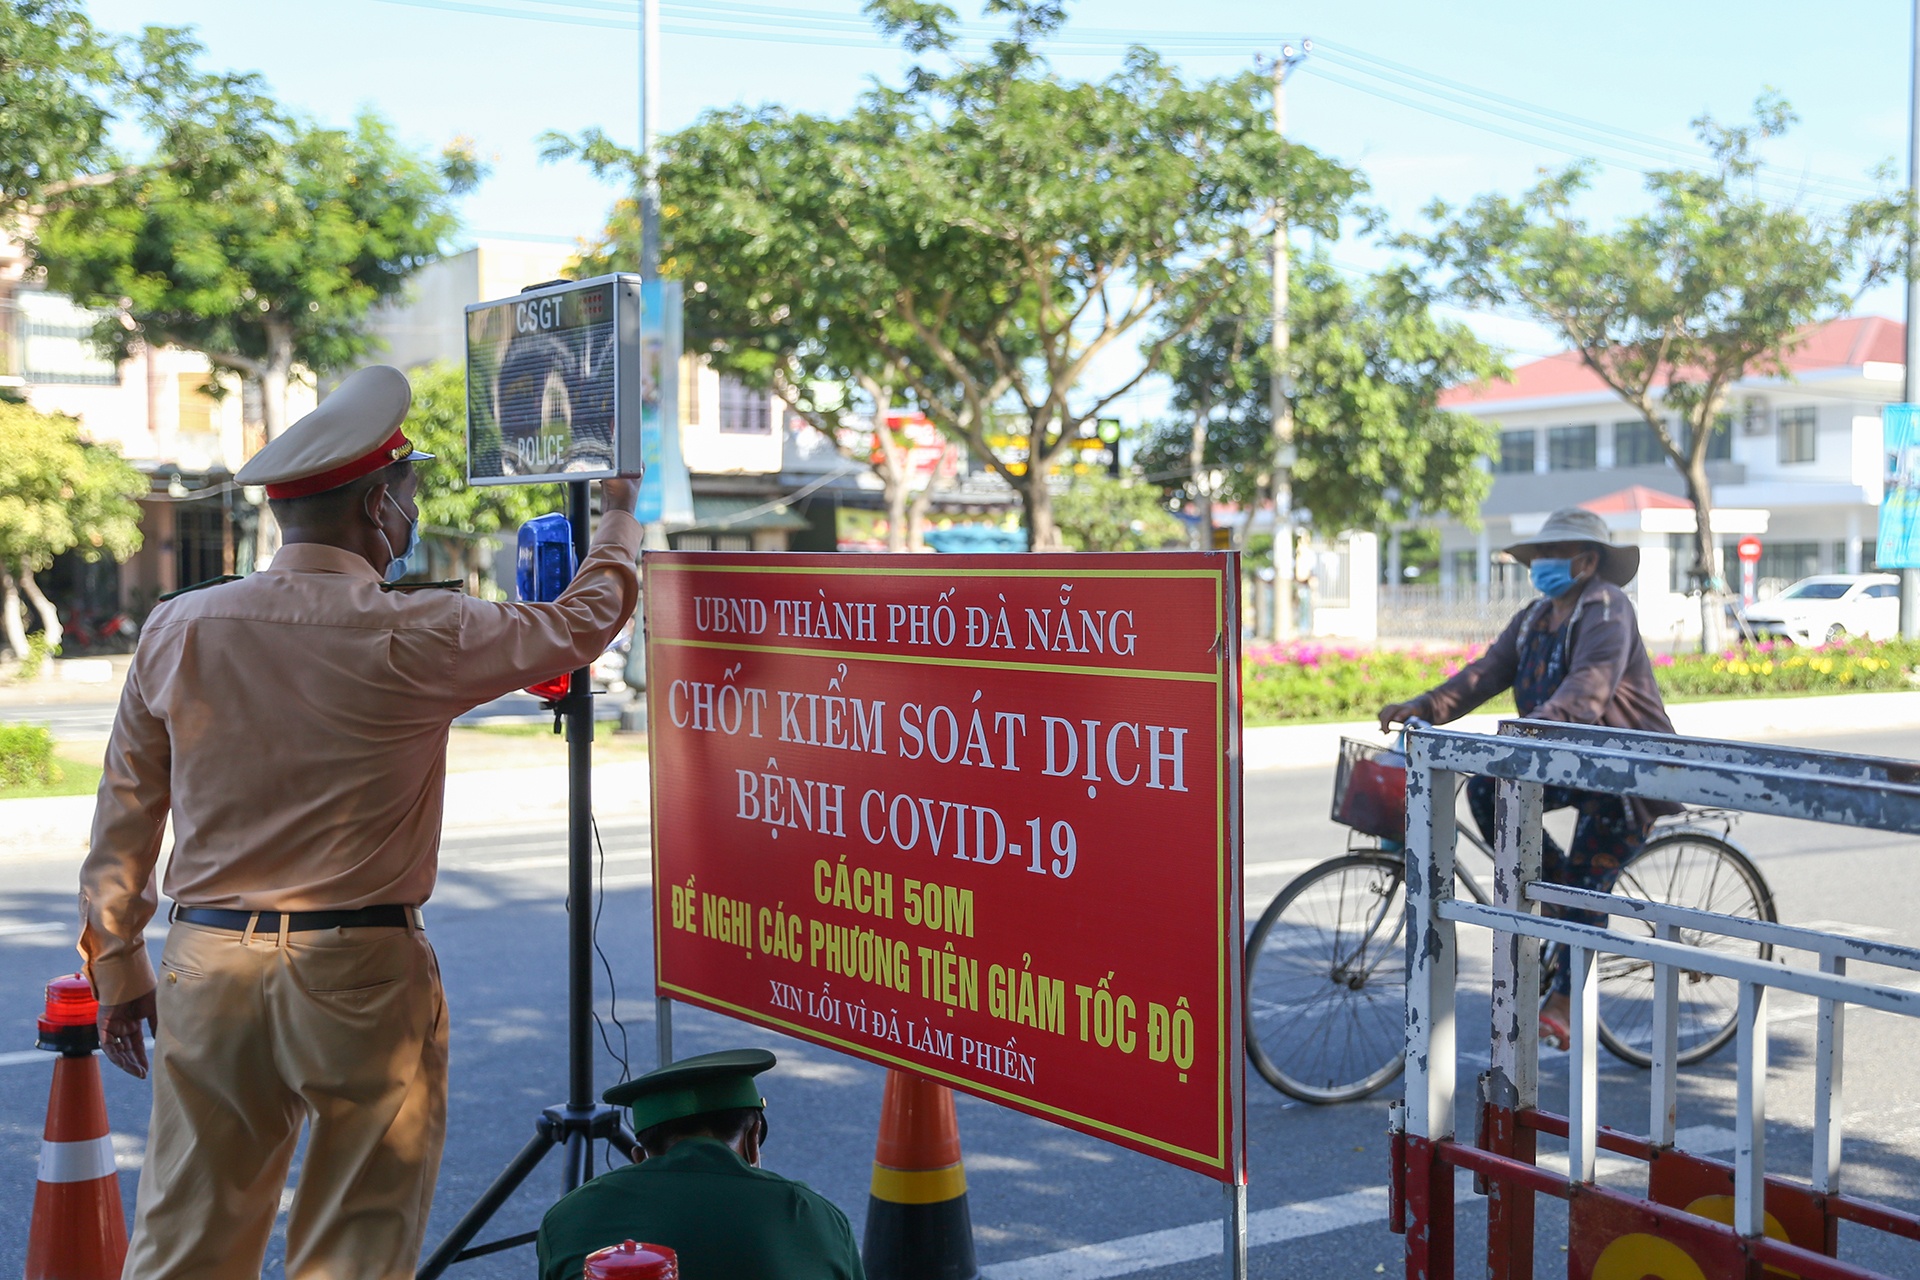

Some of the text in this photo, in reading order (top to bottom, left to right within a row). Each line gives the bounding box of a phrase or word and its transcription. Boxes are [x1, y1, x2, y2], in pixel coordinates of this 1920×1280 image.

[517, 295, 563, 333] CSGT
[517, 434, 565, 466] POLICE
[694, 583, 1138, 656] UBND THÀNH PHỐ ĐÀ NẴNG
[668, 662, 1189, 800] CHỐT KIỂM SOÁT DỊCH
[736, 756, 1079, 879] BỆNH COVID-19
[814, 854, 974, 938] CÁCH 50M
[671, 874, 1194, 1083] ĐỀ NGHỊ CÁC PHƯƠNG TIỆN GIẢM TỐC ĐỘ
[769, 980, 1037, 1085] XIN LỖI VÌ ĐÃ LÀM PHIỀN
